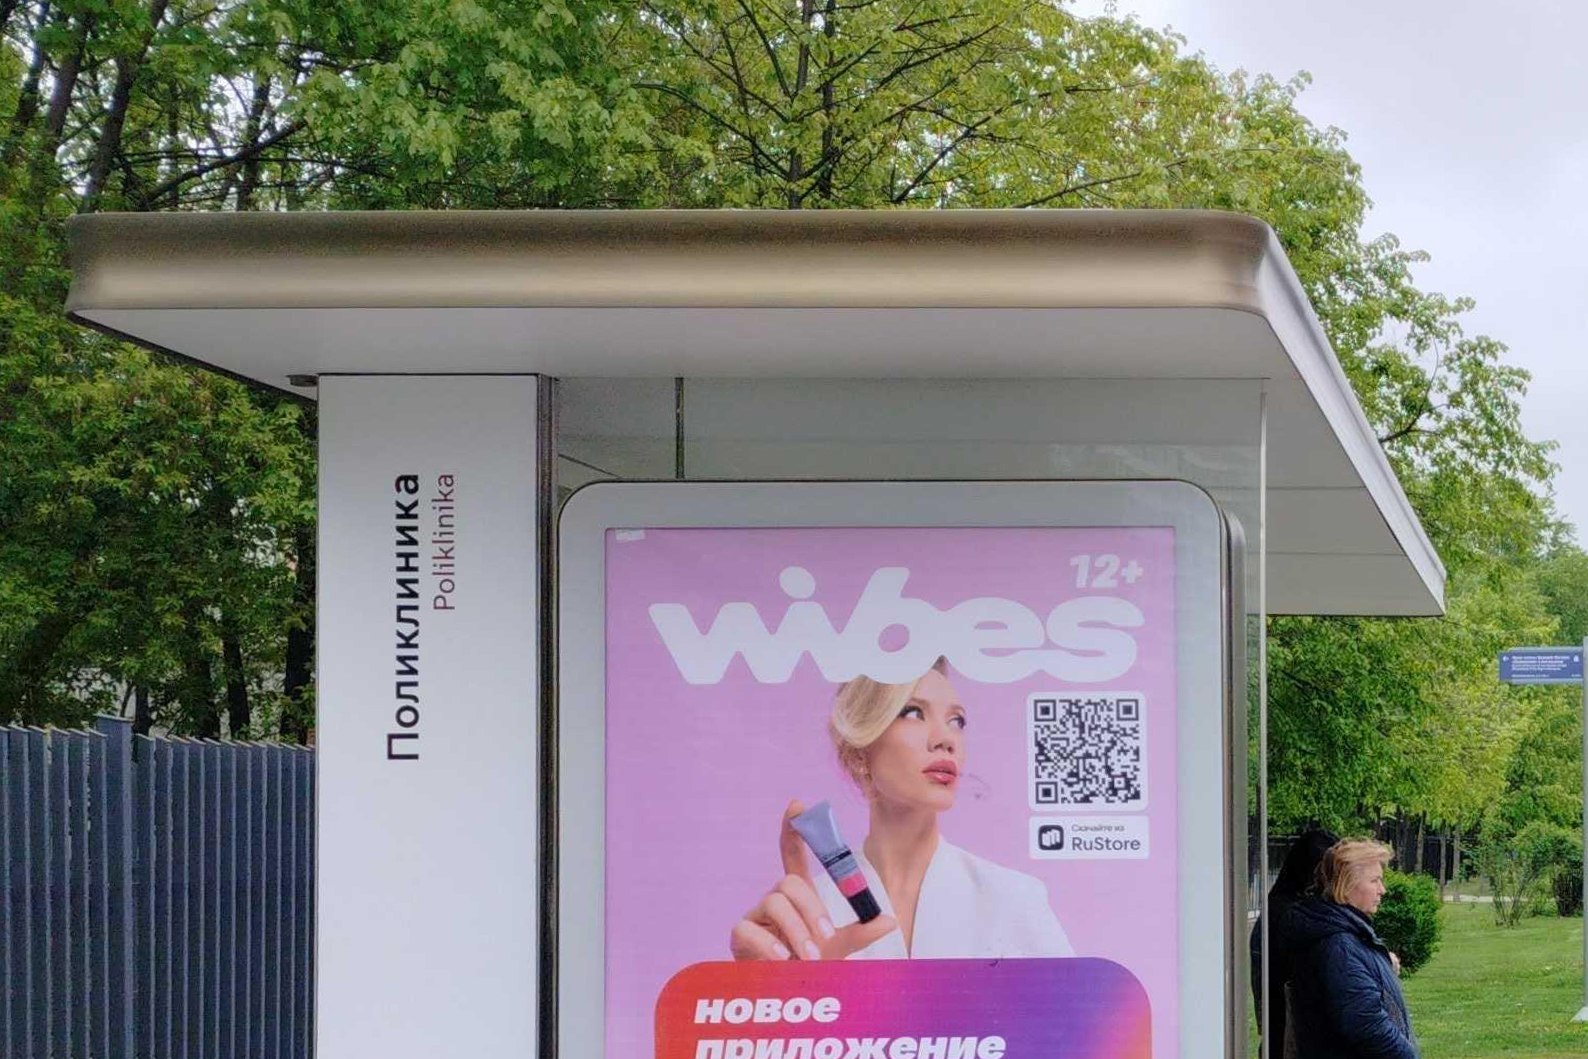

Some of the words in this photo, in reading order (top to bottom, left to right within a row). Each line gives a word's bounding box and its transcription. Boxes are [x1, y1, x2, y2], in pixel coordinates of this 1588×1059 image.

[432, 474, 455, 610] Poliklinika
[1069, 553, 1144, 589] 12+
[387, 474, 419, 760] Поликлиника
[1072, 836, 1141, 851] RuStore
[694, 996, 842, 1025] новое
